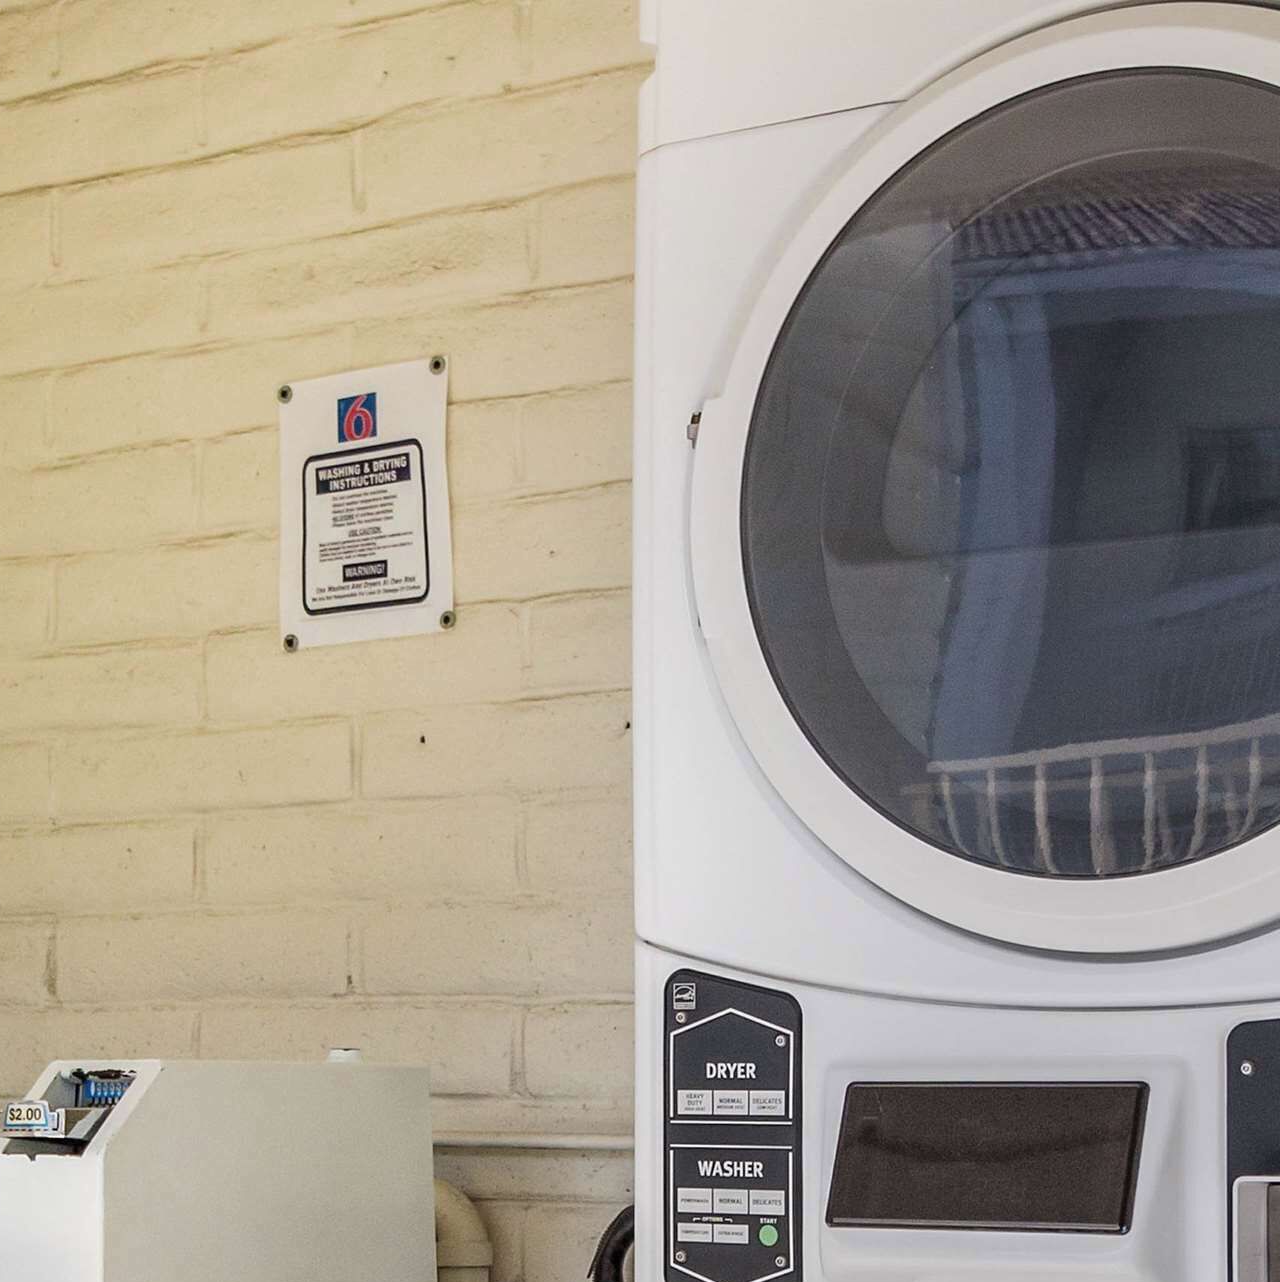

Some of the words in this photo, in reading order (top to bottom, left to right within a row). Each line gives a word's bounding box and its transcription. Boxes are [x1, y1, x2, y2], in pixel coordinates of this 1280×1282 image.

[343, 394, 373, 441] 6
[318, 464, 361, 481] WASHING
[363, 462, 371, 474] &
[372, 456, 407, 472] DRYING
[329, 470, 397, 491] INSTRUCTIONS
[344, 563, 385, 578] WARNING!
[706, 1063, 756, 1079] DRYER
[8, 1107, 42, 1121] $2.00
[698, 1160, 764, 1178] WASHER
